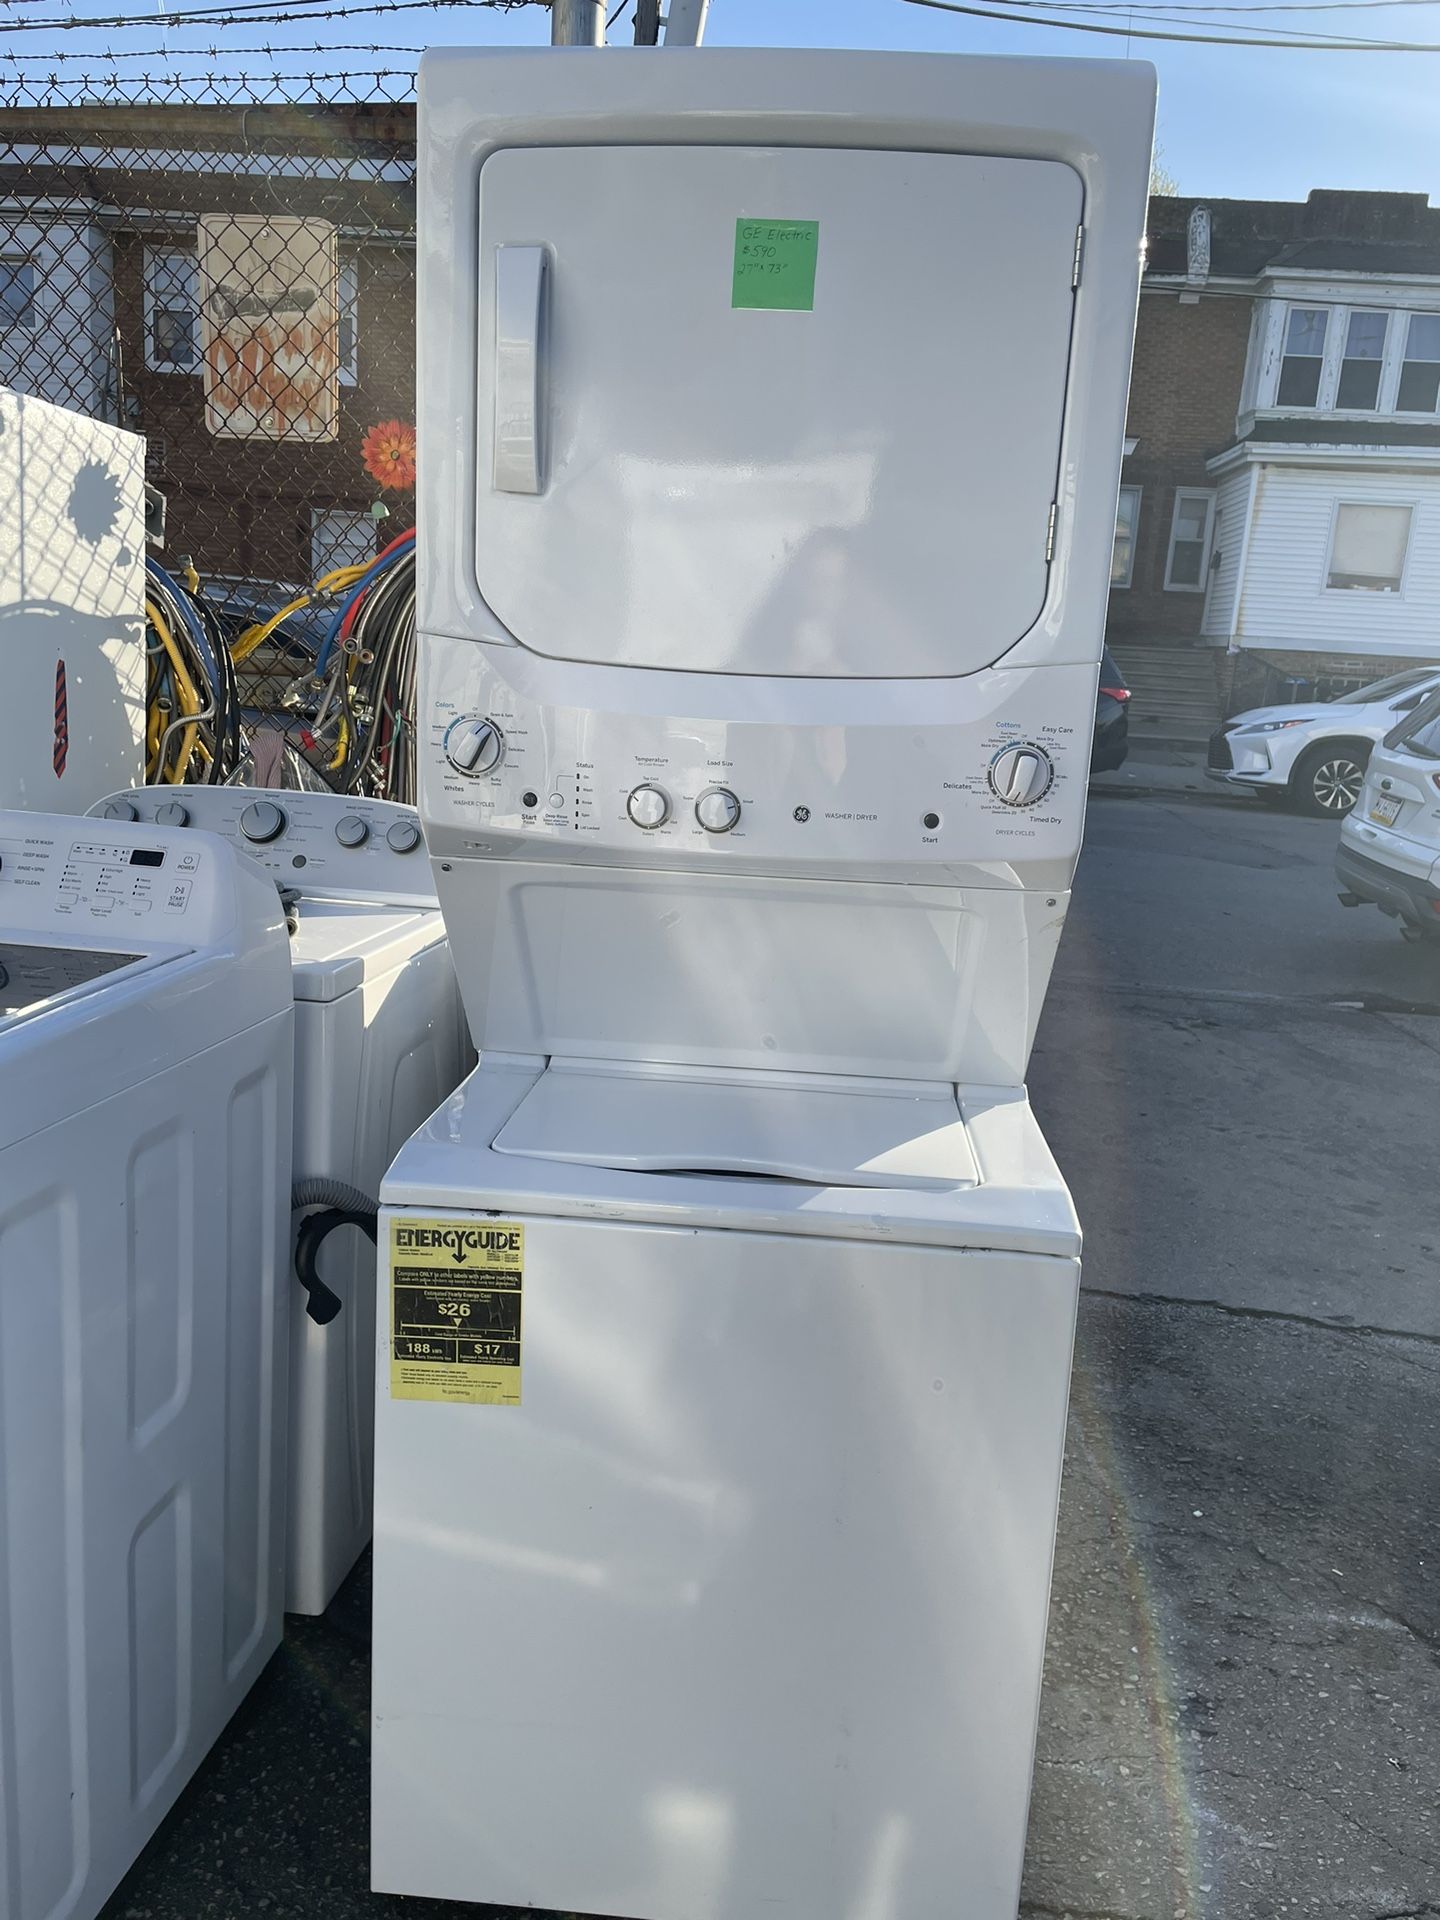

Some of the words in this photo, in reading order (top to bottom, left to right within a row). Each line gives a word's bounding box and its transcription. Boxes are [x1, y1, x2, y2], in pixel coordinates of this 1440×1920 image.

[742, 226, 762, 240] GE
[767, 228, 812, 241] Electric
[1042, 726, 1057, 734] Easy
[634, 756, 668, 764] Temperature
[943, 782, 972, 790] Delicates
[1030, 816, 1050, 824] Timed
[1050, 816, 1062, 825] Dry
[396, 1229, 520, 1250] ENERGYGUIDE
[438, 1302, 471, 1316] $26
[406, 1342, 430, 1354] 188
[474, 1344, 500, 1355] $17
